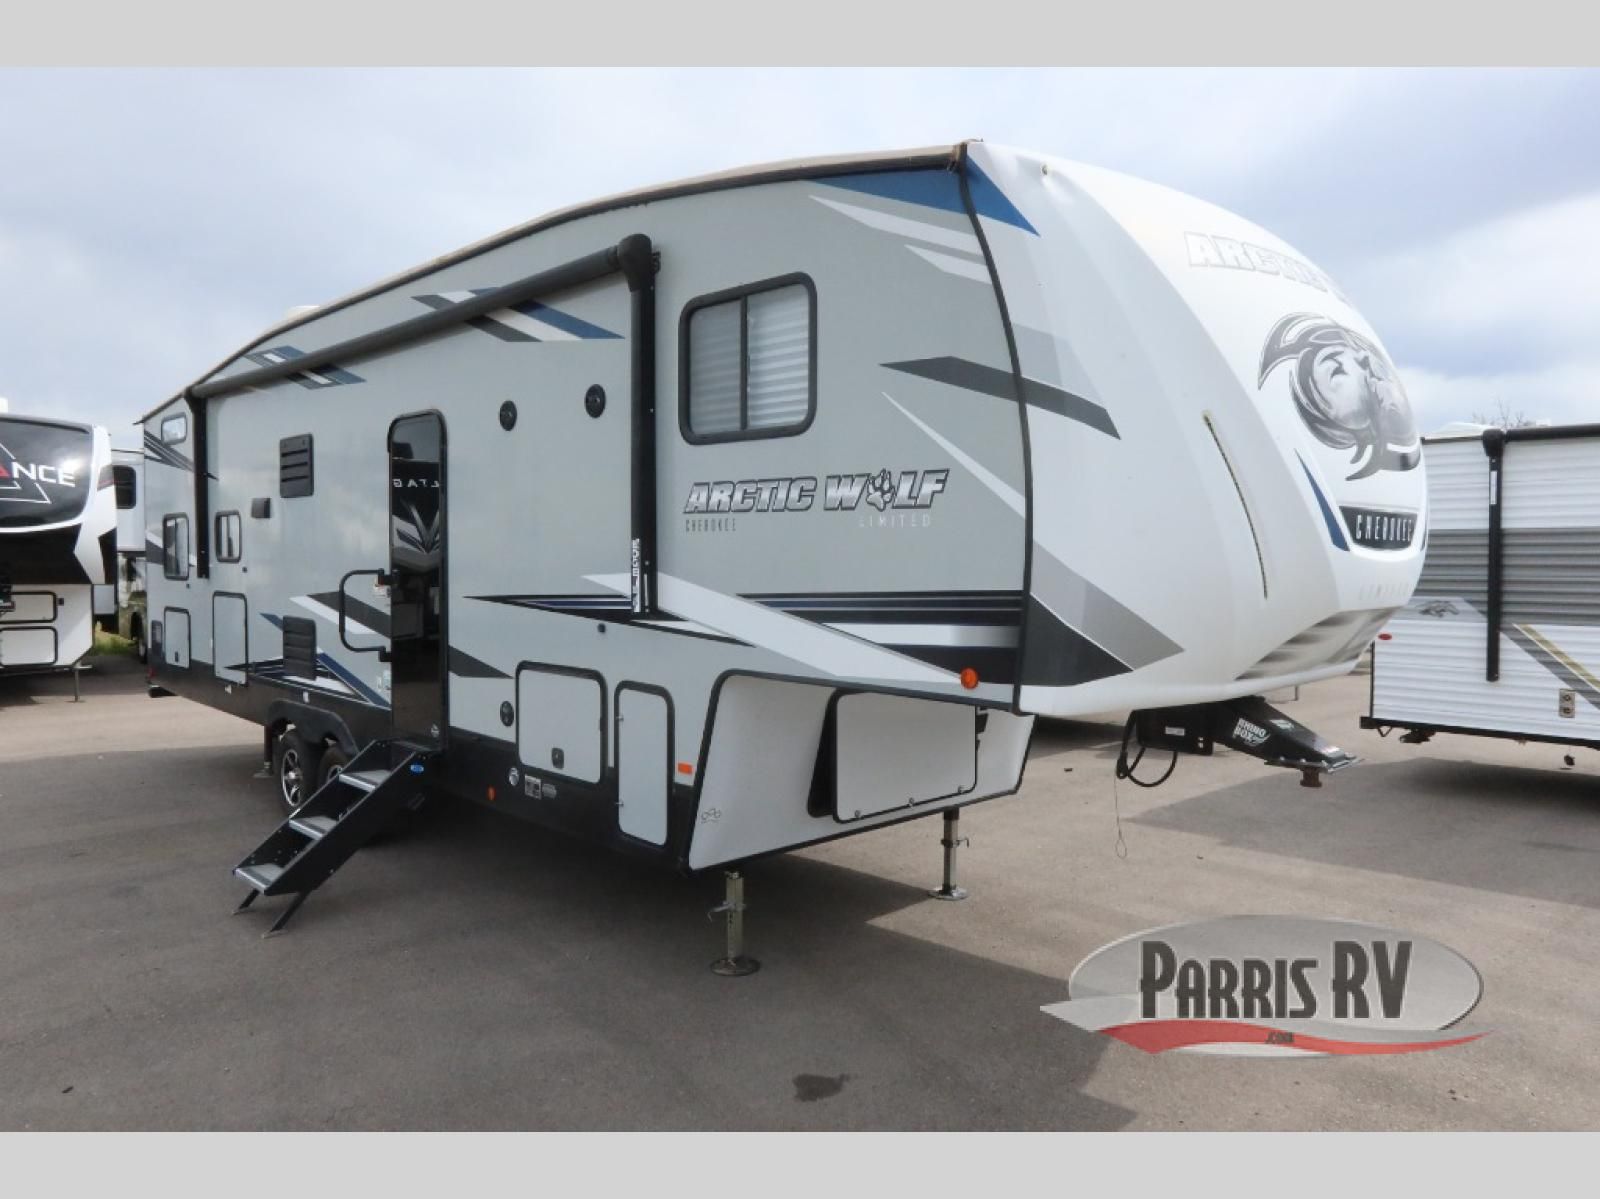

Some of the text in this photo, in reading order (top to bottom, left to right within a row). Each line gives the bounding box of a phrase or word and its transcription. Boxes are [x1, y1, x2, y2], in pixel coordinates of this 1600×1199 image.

[683, 476, 818, 514] ARCTIC
[685, 514, 931, 532] CHEROKEE LIMITED
[1355, 514, 1414, 542] CHEROKEE
